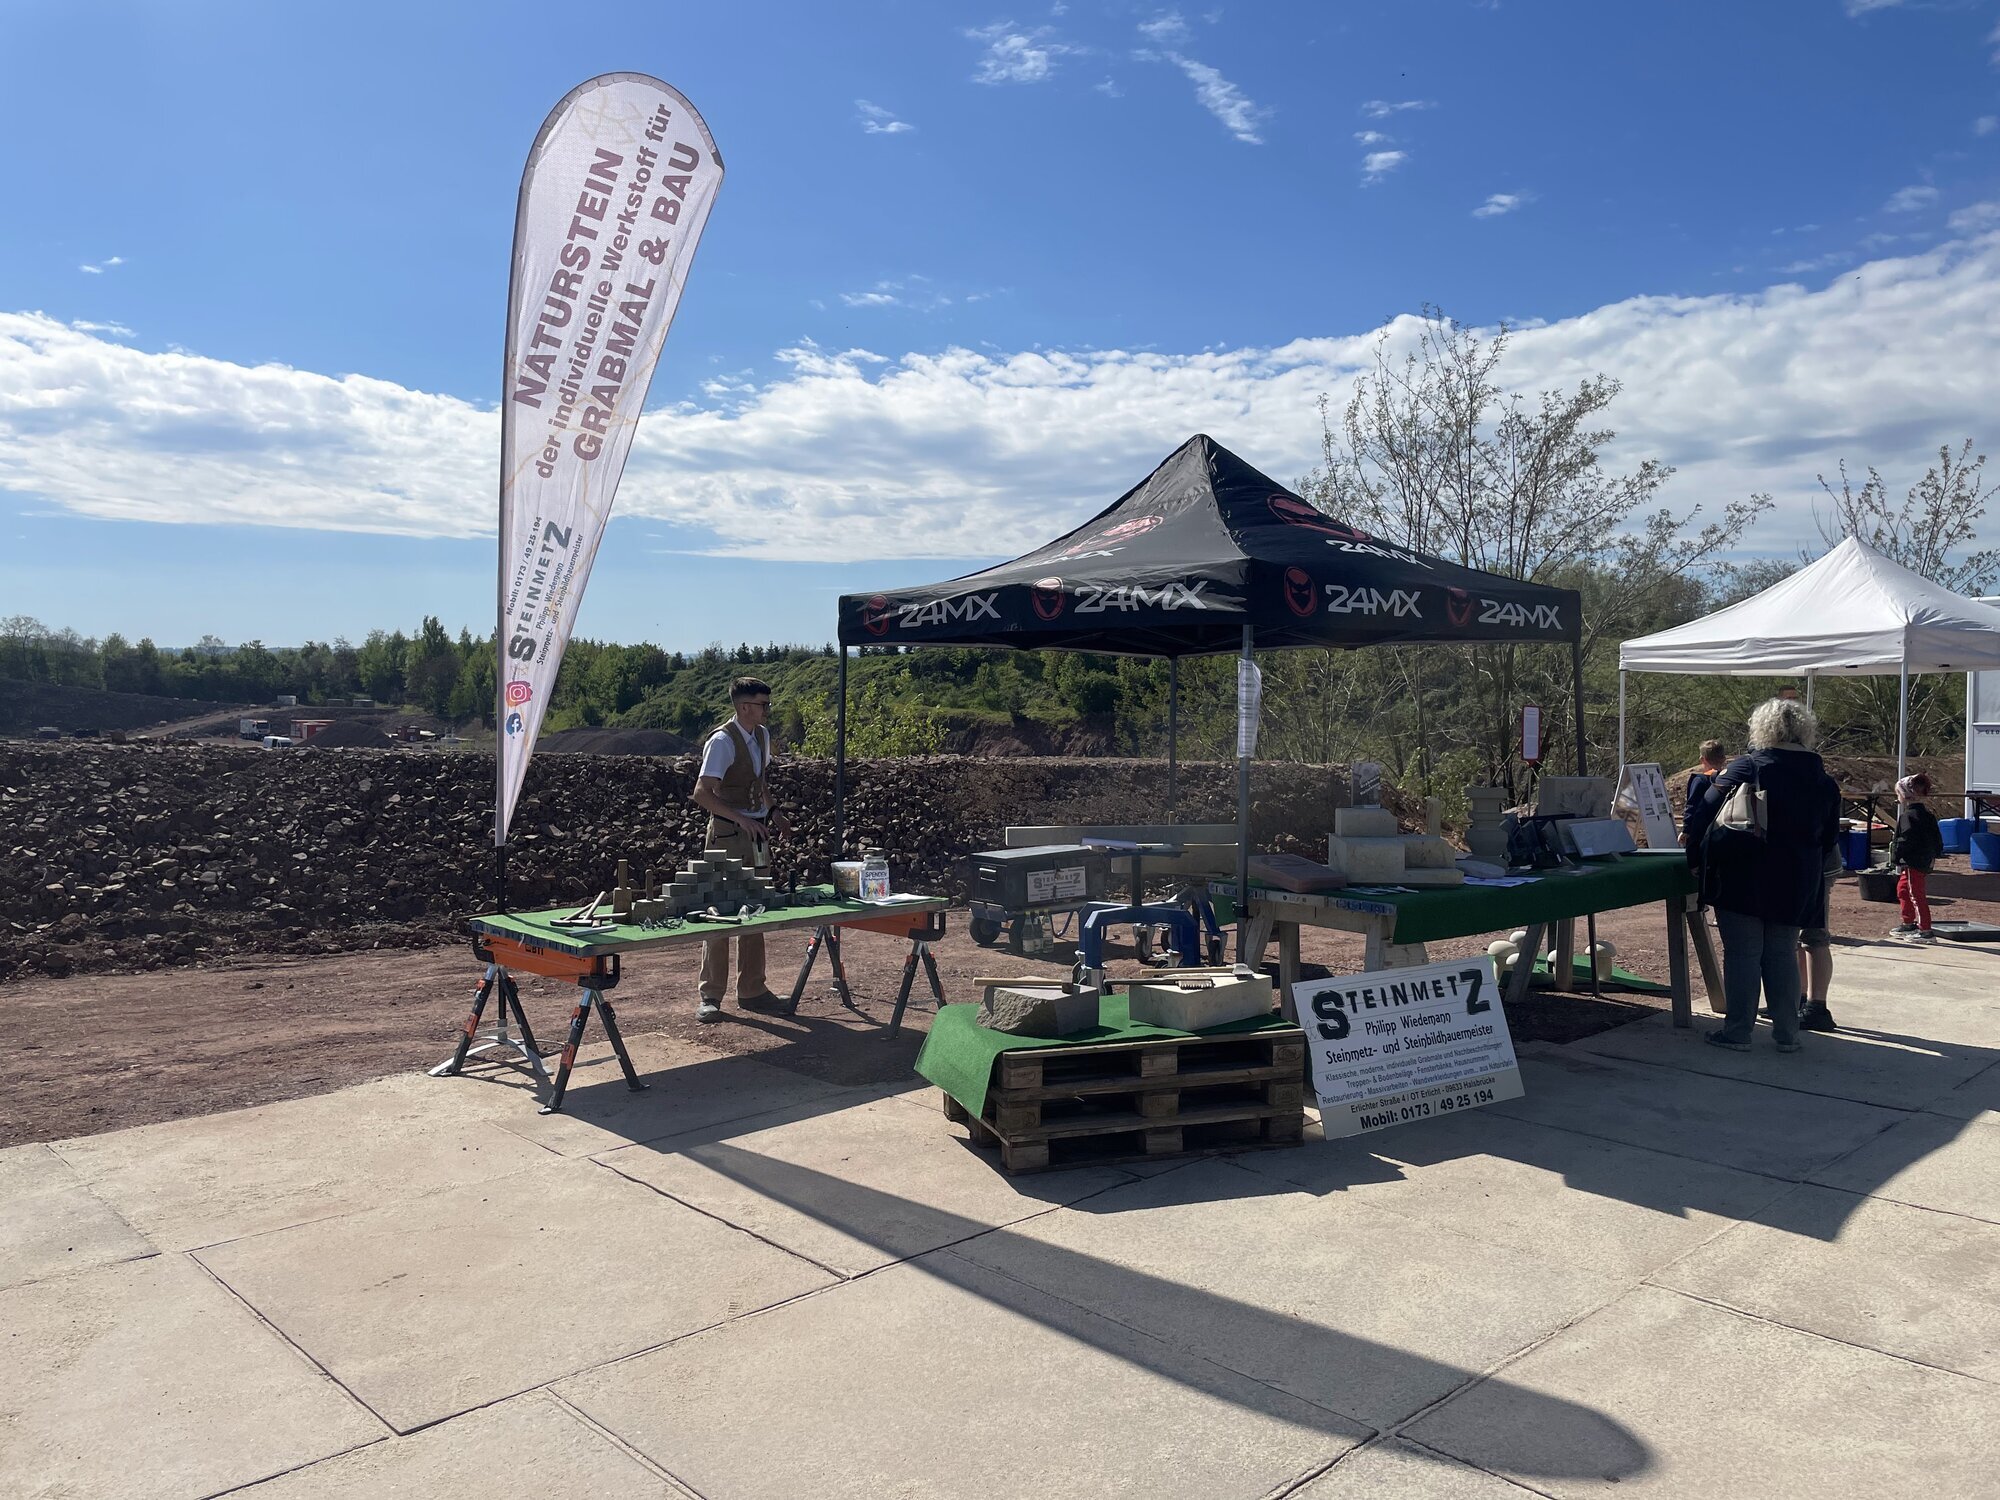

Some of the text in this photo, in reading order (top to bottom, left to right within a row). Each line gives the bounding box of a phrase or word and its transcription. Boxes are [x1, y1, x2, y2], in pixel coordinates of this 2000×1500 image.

[512, 148, 624, 409] NATURSTEIN
[536, 103, 672, 479] der individuelle Werkstoff für
[573, 142, 700, 461] GRABMAL & BAU
[528, 534, 537, 546] 25
[533, 516, 543, 533] 194
[524, 547, 533, 559] 49
[508, 520, 573, 663] STEINMETZ
[515, 566, 527, 587] 0173
[551, 609, 560, 625] und
[556, 533, 584, 608] Steinbildhauermeister
[506, 589, 520, 616] Mobil:
[536, 562, 565, 630] Philipp Wiedemann
[1324, 584, 1423, 619] 24MX
[1478, 599, 1564, 631] 24MX
[1311, 968, 1492, 1041] STEINMETZ
[1365, 1012, 1452, 1036] Philipp Wiedemann
[1325, 1024, 1494, 1065] Steinmetz- und Steinbildhauermeister
[1443, 1050, 1454, 1059] und
[1350, 1101, 1379, 1114] Erlichter
[1410, 1090, 1420, 1101] OT
[1420, 1087, 1441, 1099] Erlicht
[1360, 1110, 1399, 1130] Mobil:
[1401, 1103, 1430, 1121] 0173
[1440, 1097, 1454, 1112] 49
[1457, 1093, 1471, 1107] 25
[1474, 1088, 1494, 1104] 194
